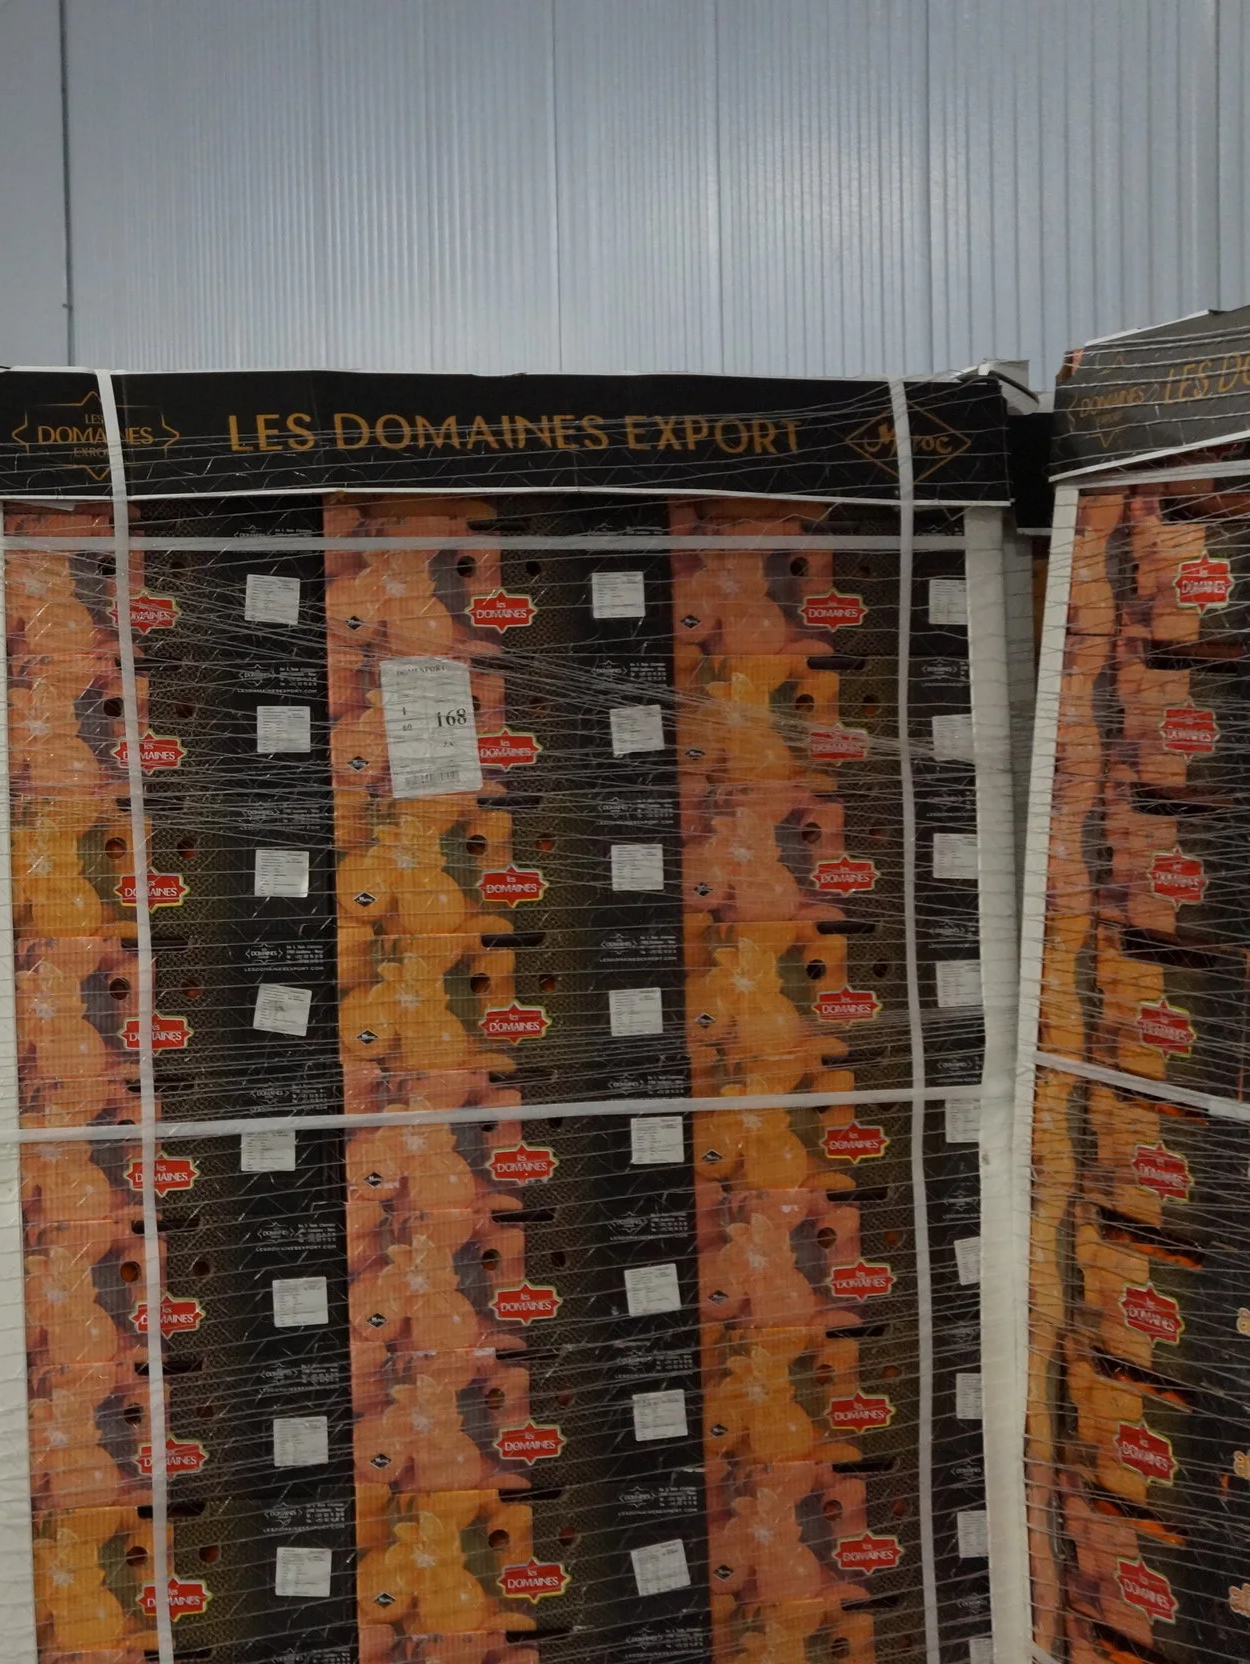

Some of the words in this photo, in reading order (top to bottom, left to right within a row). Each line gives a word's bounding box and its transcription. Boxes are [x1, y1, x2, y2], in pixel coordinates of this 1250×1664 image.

[37, 425, 155, 446] DOMANES
[228, 413, 316, 451] LES
[333, 412, 609, 451] DOMAINES
[624, 415, 801, 454] EXPORT
[74, 446, 110, 459] EXPO
[1182, 580, 1226, 593] DOMAINES
[476, 609, 526, 618] DOMAINES
[809, 609, 858, 618] DOMAINES
[437, 708, 468, 728] 168
[123, 752, 175, 760] DMAINES
[480, 747, 531, 756] DOMAINES
[821, 873, 870, 883] DOMAINES
[486, 883, 537, 893] DOMAINES
[822, 1004, 871, 1013] DOMAINES
[490, 1021, 540, 1031] DOMAINES
[830, 1140, 879, 1149] DOMAINES
[497, 1162, 548, 1172] DOMAINES
[136, 1172, 188, 1182] DMAINES
[836, 1278, 886, 1288] DOMAINES
[501, 1301, 551, 1311] DOMAINES
[141, 1314, 193, 1324] DMAINES
[834, 1410, 884, 1420] DOMAINES
[505, 1441, 555, 1450] DOMAINES
[843, 1551, 893, 1560] DOMAINES
[508, 1577, 558, 1587] DOMAINES
